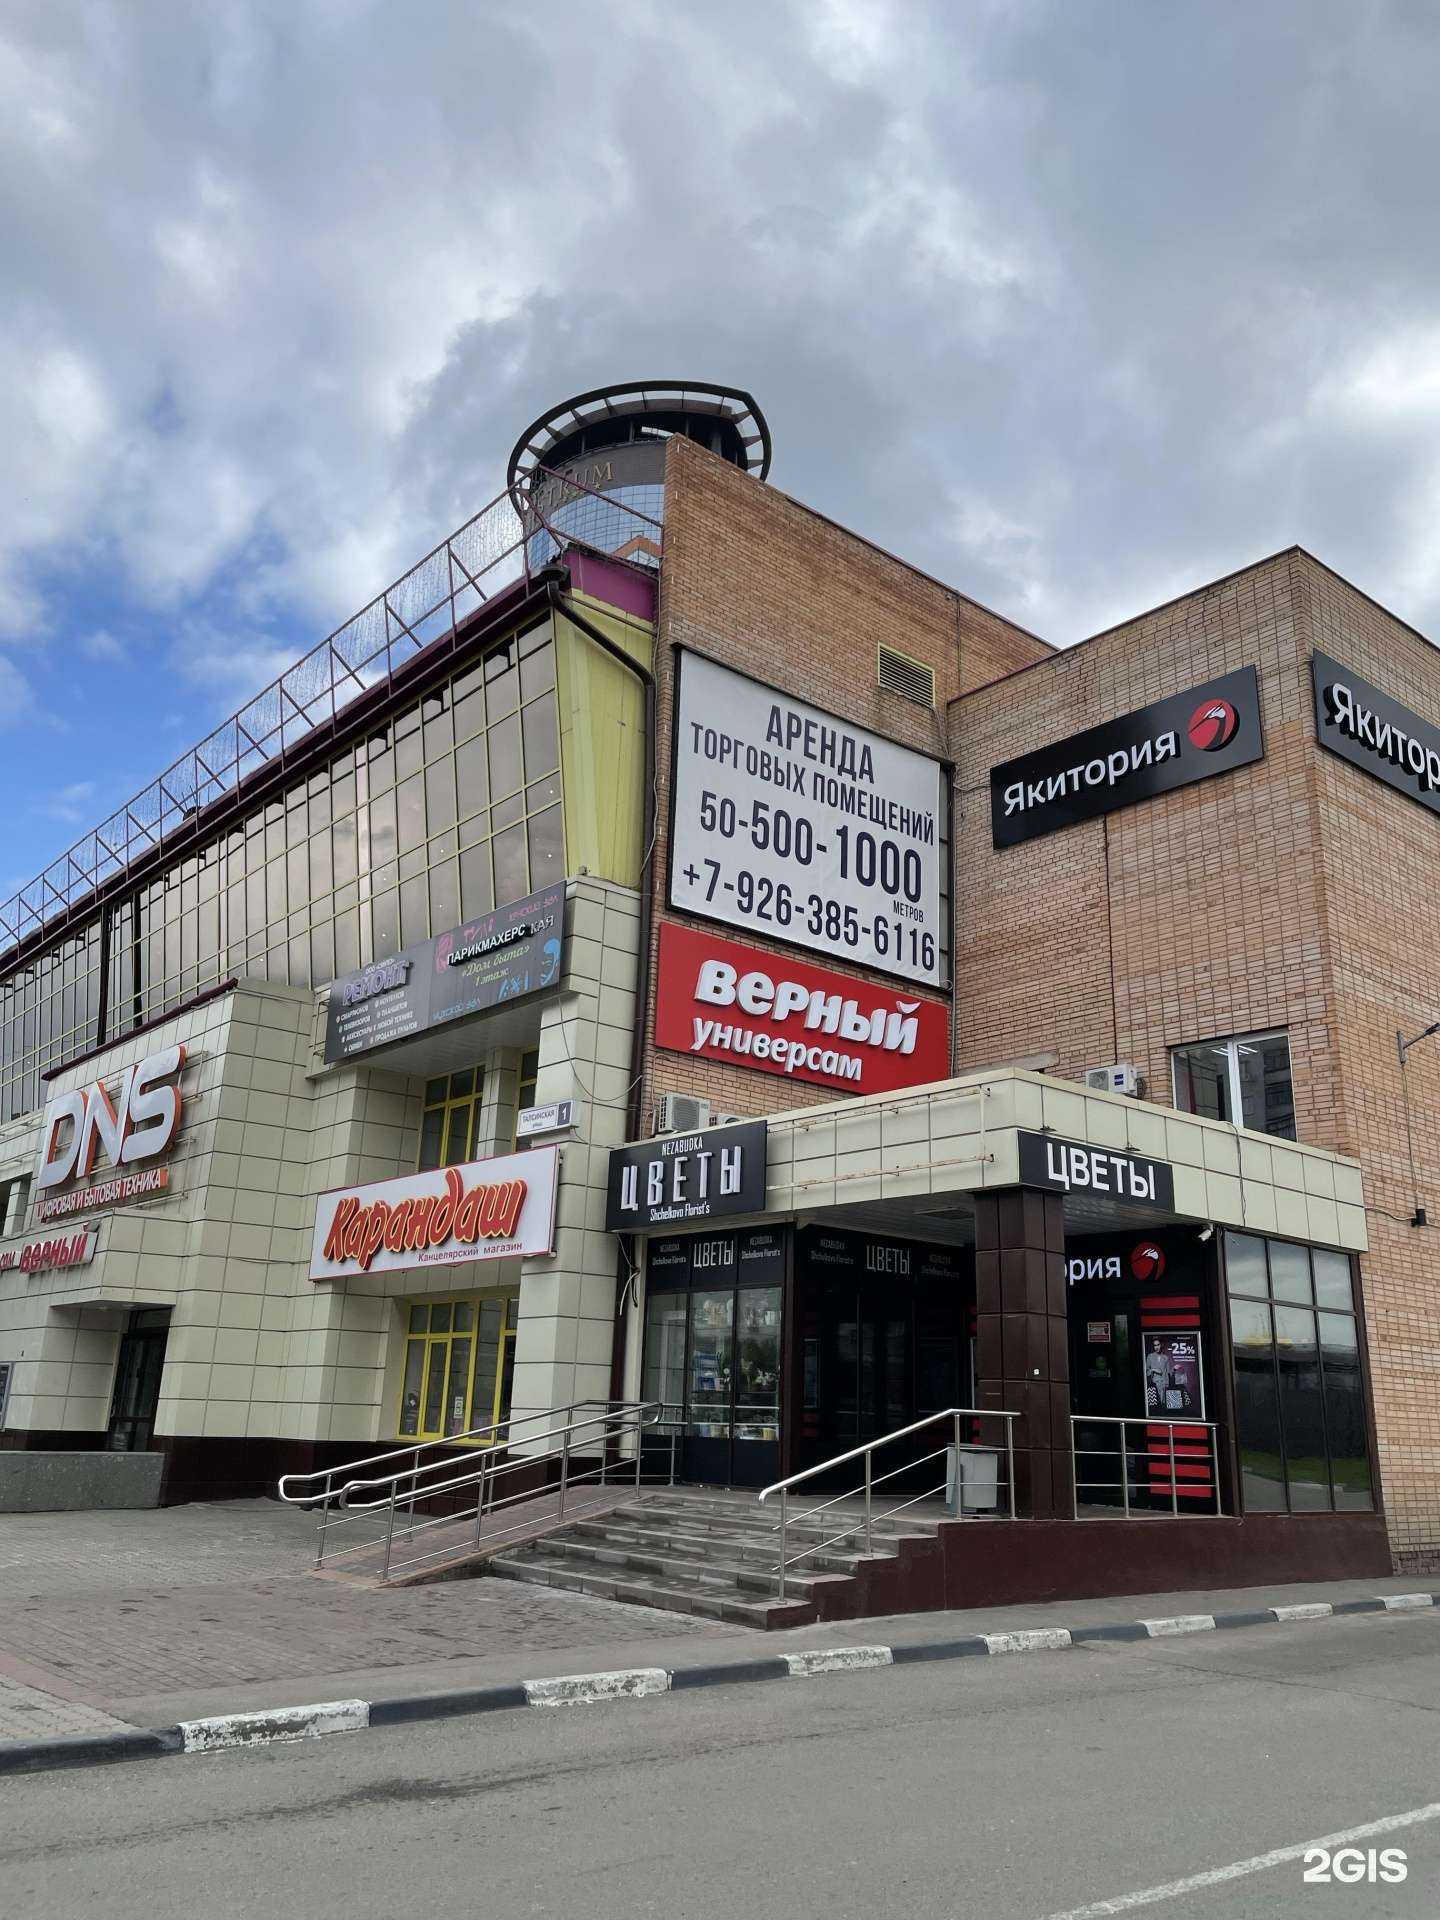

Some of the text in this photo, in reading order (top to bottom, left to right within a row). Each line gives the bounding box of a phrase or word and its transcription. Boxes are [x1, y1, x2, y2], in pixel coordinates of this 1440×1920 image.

[766, 704, 875, 784] АРЕНДА
[690, 721, 934, 846] ТОРГОВЫХ ПОМЕЩЕНИЙ
[1004, 730, 1178, 817] Якитория
[700, 790, 922, 903] 50-500-1000
[683, 858, 935, 971] +7-926-385-6116
[893, 899, 924, 923] МЕТРОВ
[343, 960, 409, 1006] РЕМОНТ
[690, 1017, 862, 1081] универсам
[37, 1044, 186, 1190] DNS
[562, 1104, 568, 1121] 1
[662, 1136, 703, 1156] NEZABUDKA
[85, 1180, 121, 1207] БЫТОВАЯ
[122, 1168, 161, 1196] ТЕХНИКА
[621, 1146, 741, 1211] ЦВЕТЫ
[1046, 1142, 1156, 1200] ЦВЕТЫ
[323, 1167, 528, 1271] Карандаш
[684, 1201, 711, 1217] Florist's
[418, 1242, 523, 1262] Канцелярский магазин
[693, 1239, 734, 1269] ЦВЕТЫ
[866, 1244, 911, 1275] ЦВЕТЫ
[1064, 1256, 1121, 1287] рия
[1168, 1342, 1196, 1355] -25%
